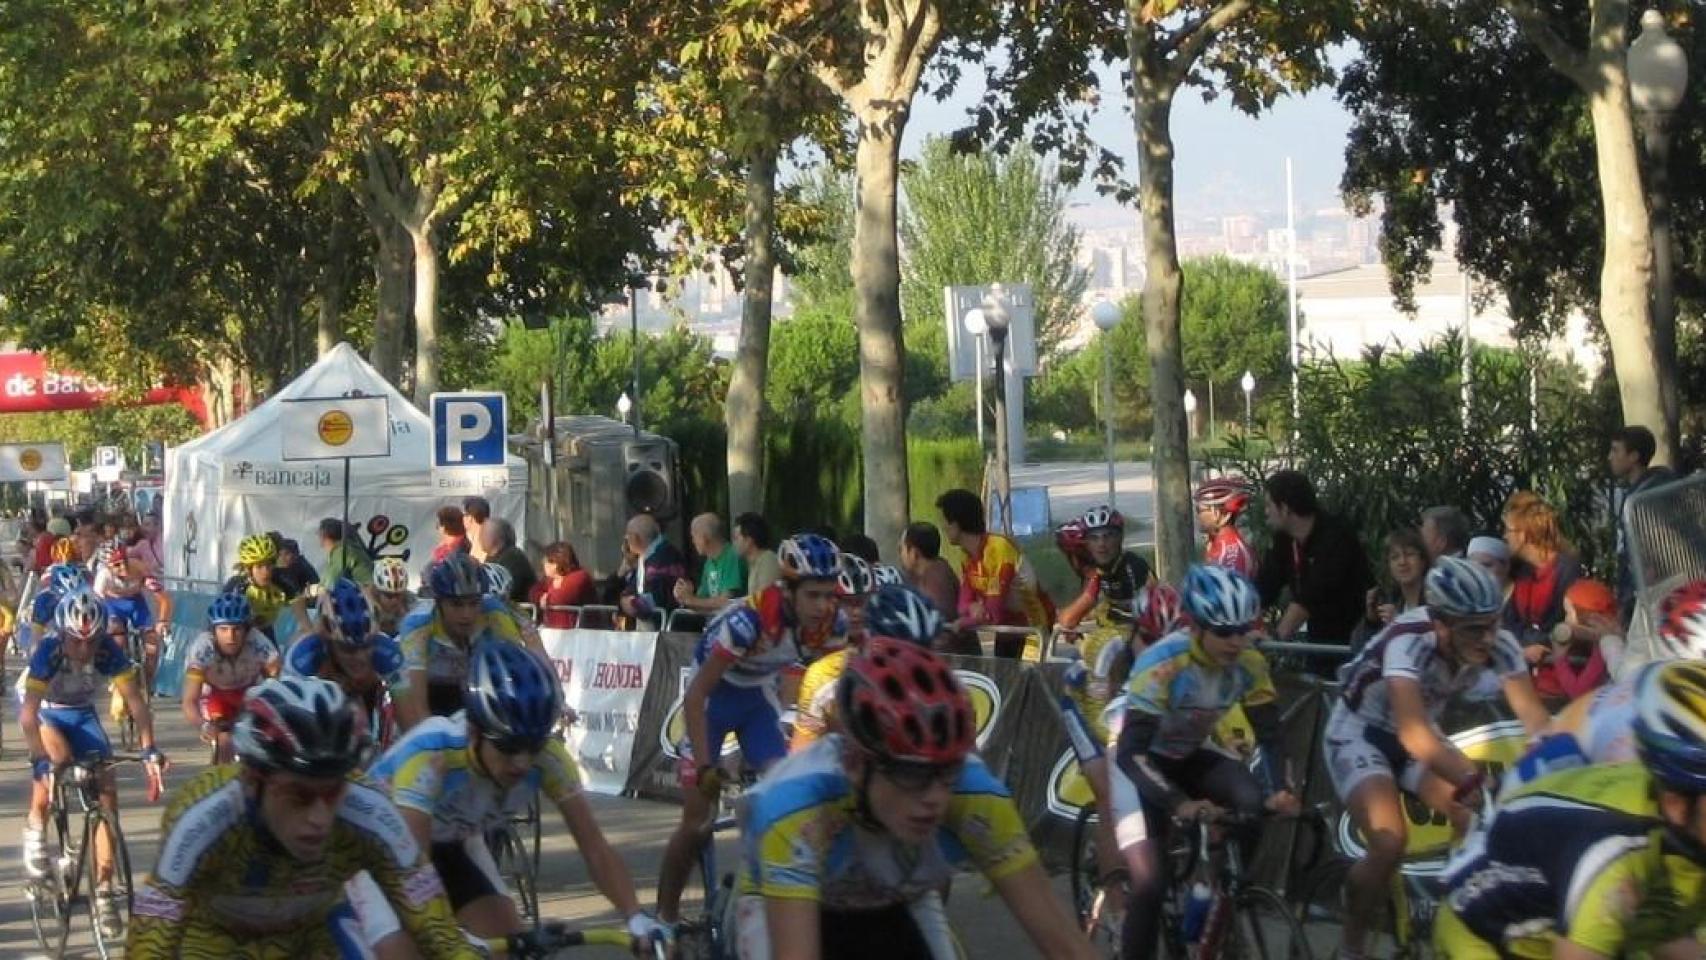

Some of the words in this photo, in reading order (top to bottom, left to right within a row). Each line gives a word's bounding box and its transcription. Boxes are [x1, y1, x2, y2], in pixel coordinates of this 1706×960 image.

[5, 372, 37, 397] de
[445, 401, 492, 462] P
[101, 449, 114, 466] P
[255, 465, 331, 490] Bancaja
